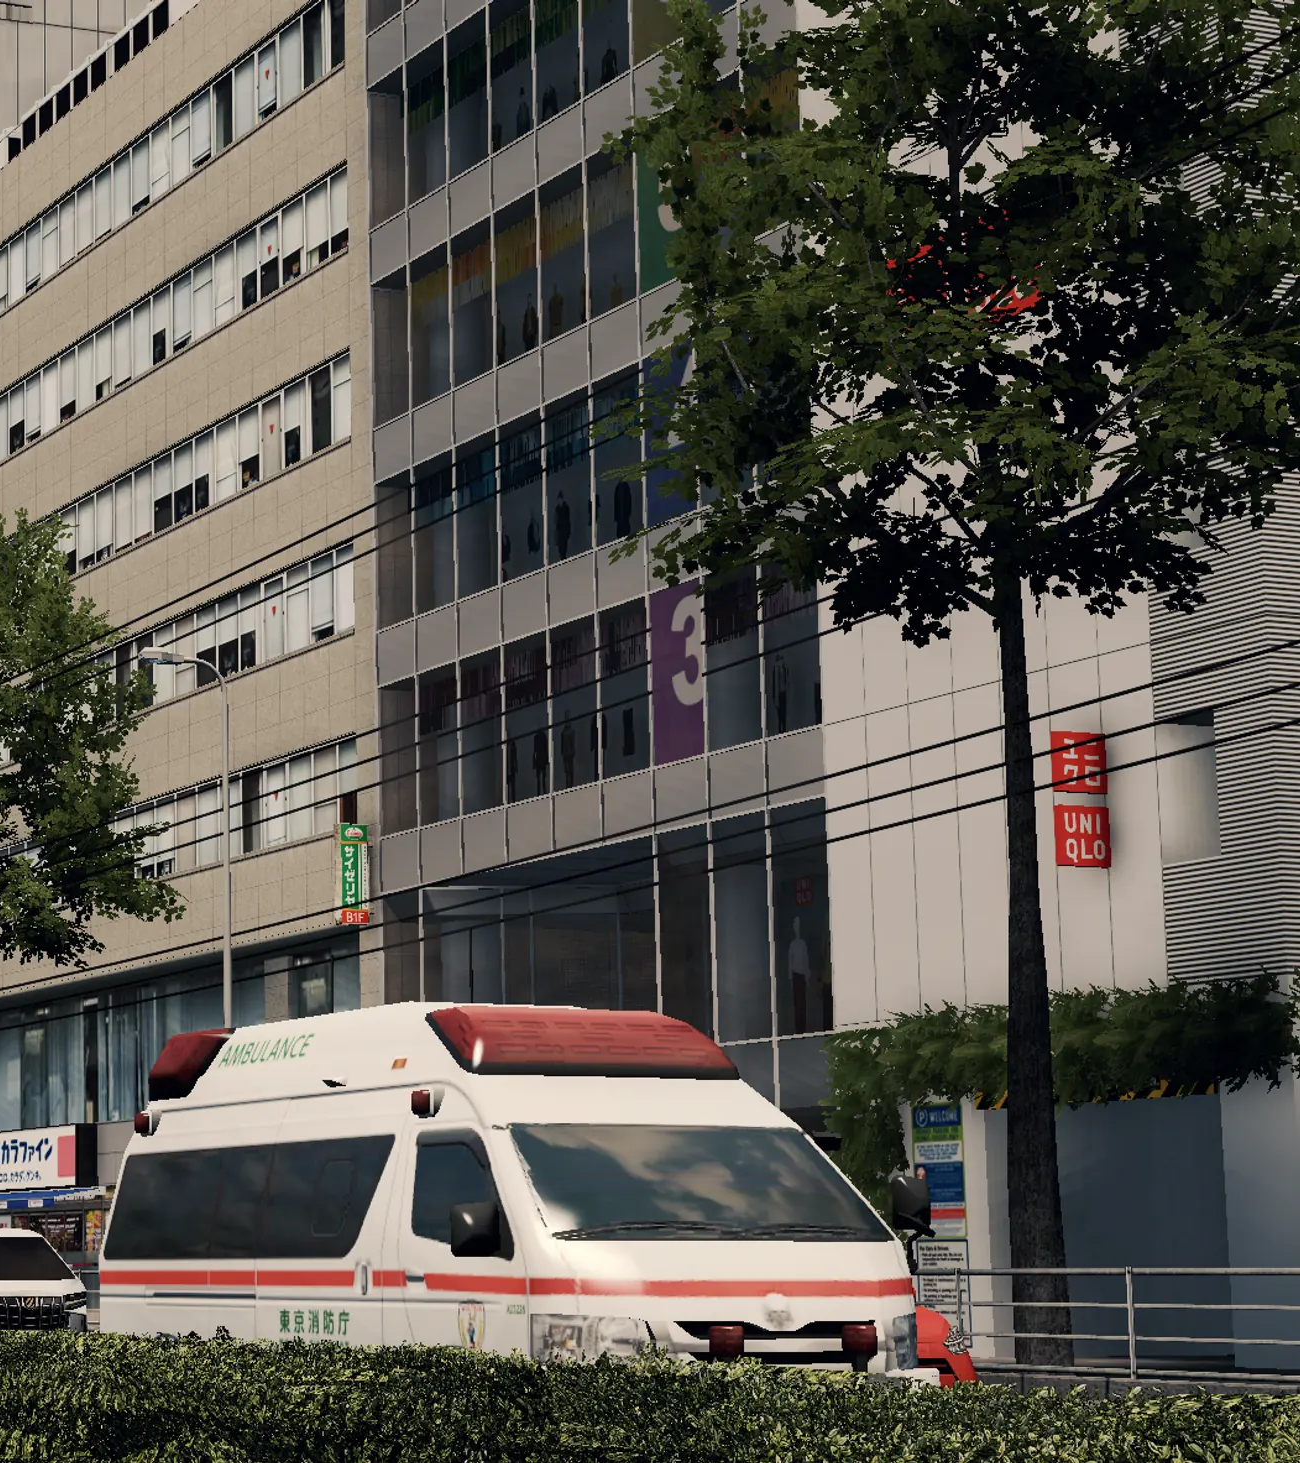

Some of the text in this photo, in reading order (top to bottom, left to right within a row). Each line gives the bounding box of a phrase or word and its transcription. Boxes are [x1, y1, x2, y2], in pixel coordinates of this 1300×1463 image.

[671, 593, 703, 706] 3
[1063, 764, 1101, 787] クロ
[1063, 812, 1101, 835] UNI
[1065, 838, 1106, 863] QLO
[344, 845, 356, 906] サイゼリヤ
[345, 911, 366, 923] B1F
[218, 1033, 315, 1068] AMBULANCE
[279, 1309, 350, 1336] 東京消防庁
